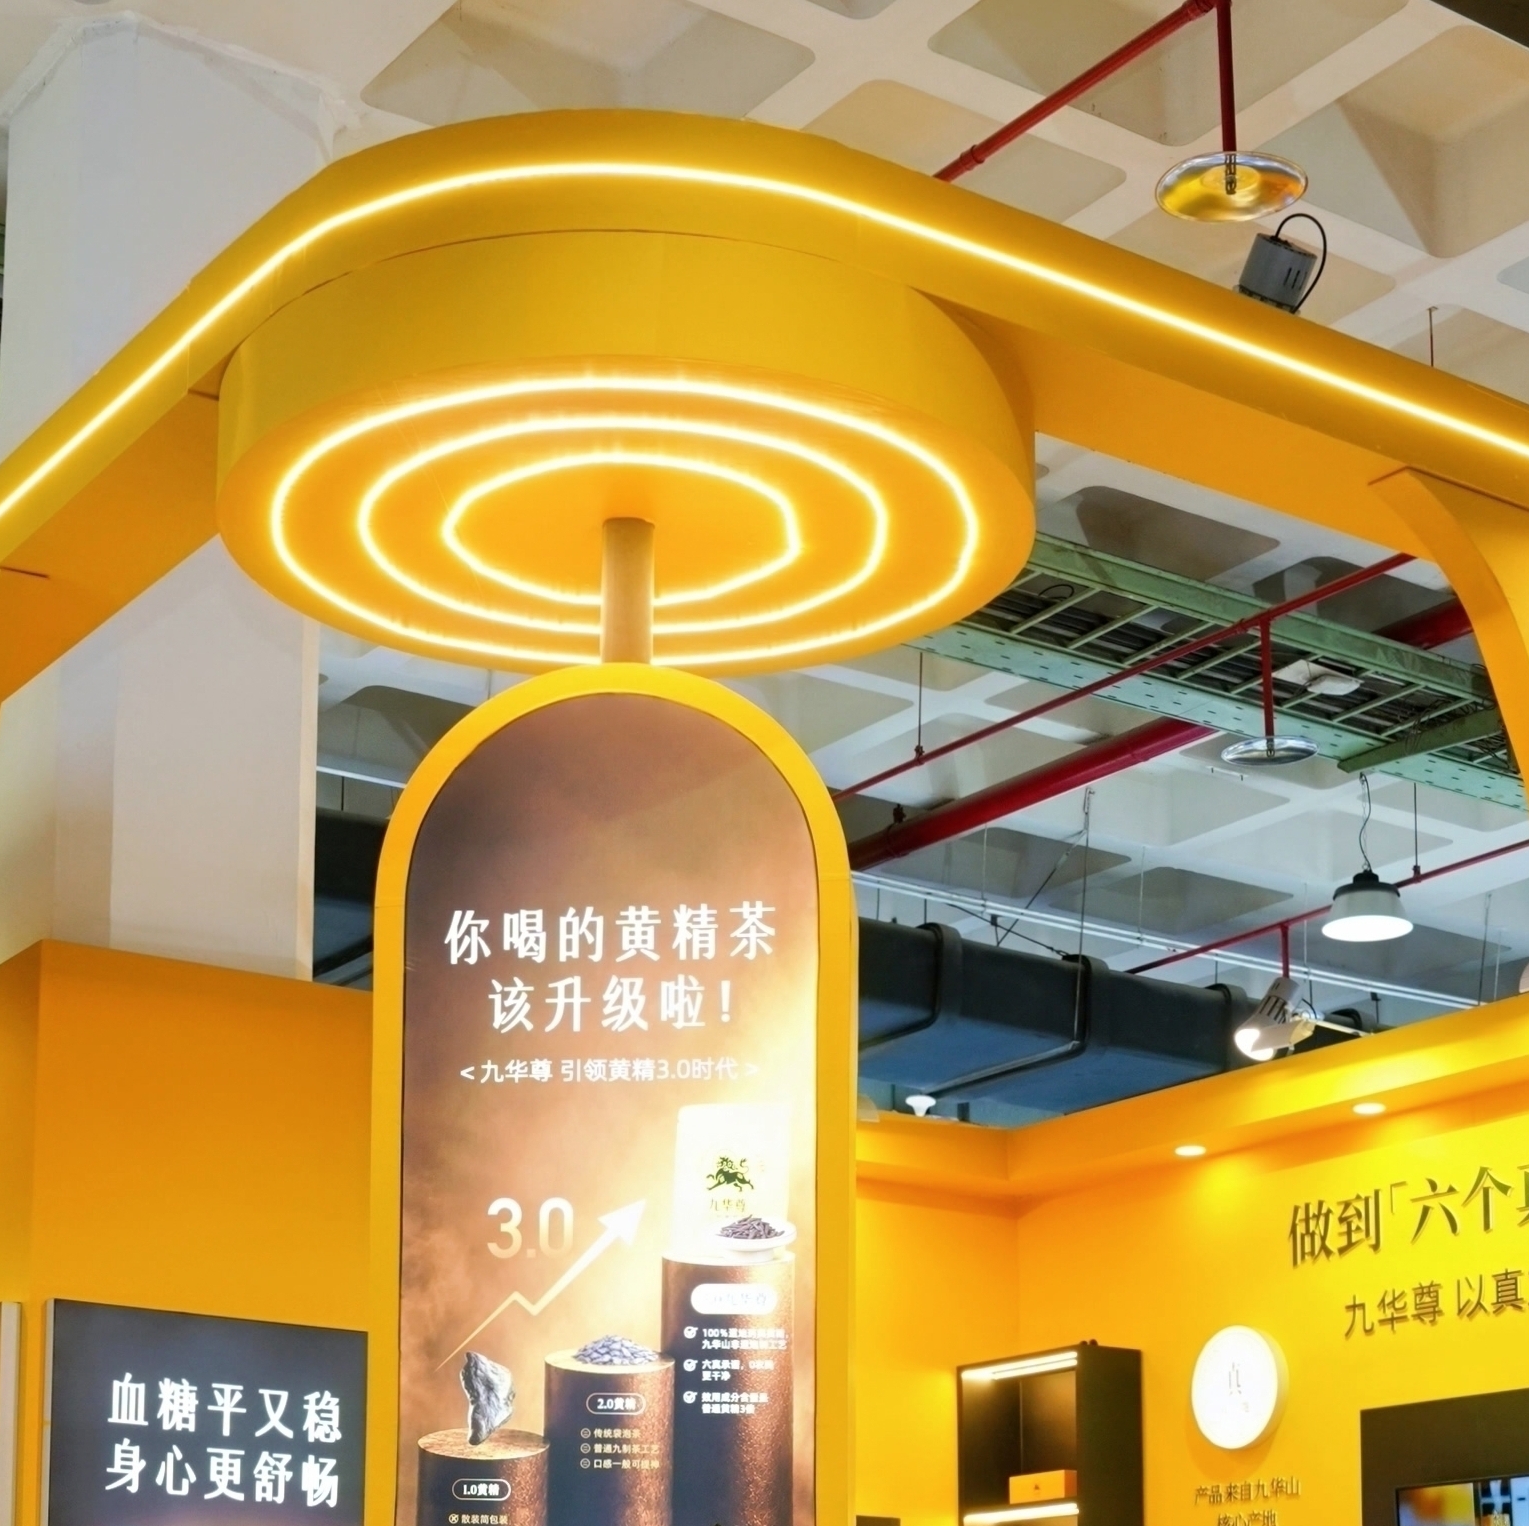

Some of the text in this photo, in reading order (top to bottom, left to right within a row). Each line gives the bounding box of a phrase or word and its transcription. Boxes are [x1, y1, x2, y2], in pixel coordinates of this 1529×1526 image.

[444, 900, 776, 965] 你喝的黄精茶
[487, 1197, 574, 1260] 3.0
[1344, 1279, 1443, 1340] 九华尊
[108, 1372, 342, 1444] 血糖平又稳
[105, 1438, 340, 1508] 身心更舒畅
[1194, 1476, 1300, 1506] 产品来自九华山
